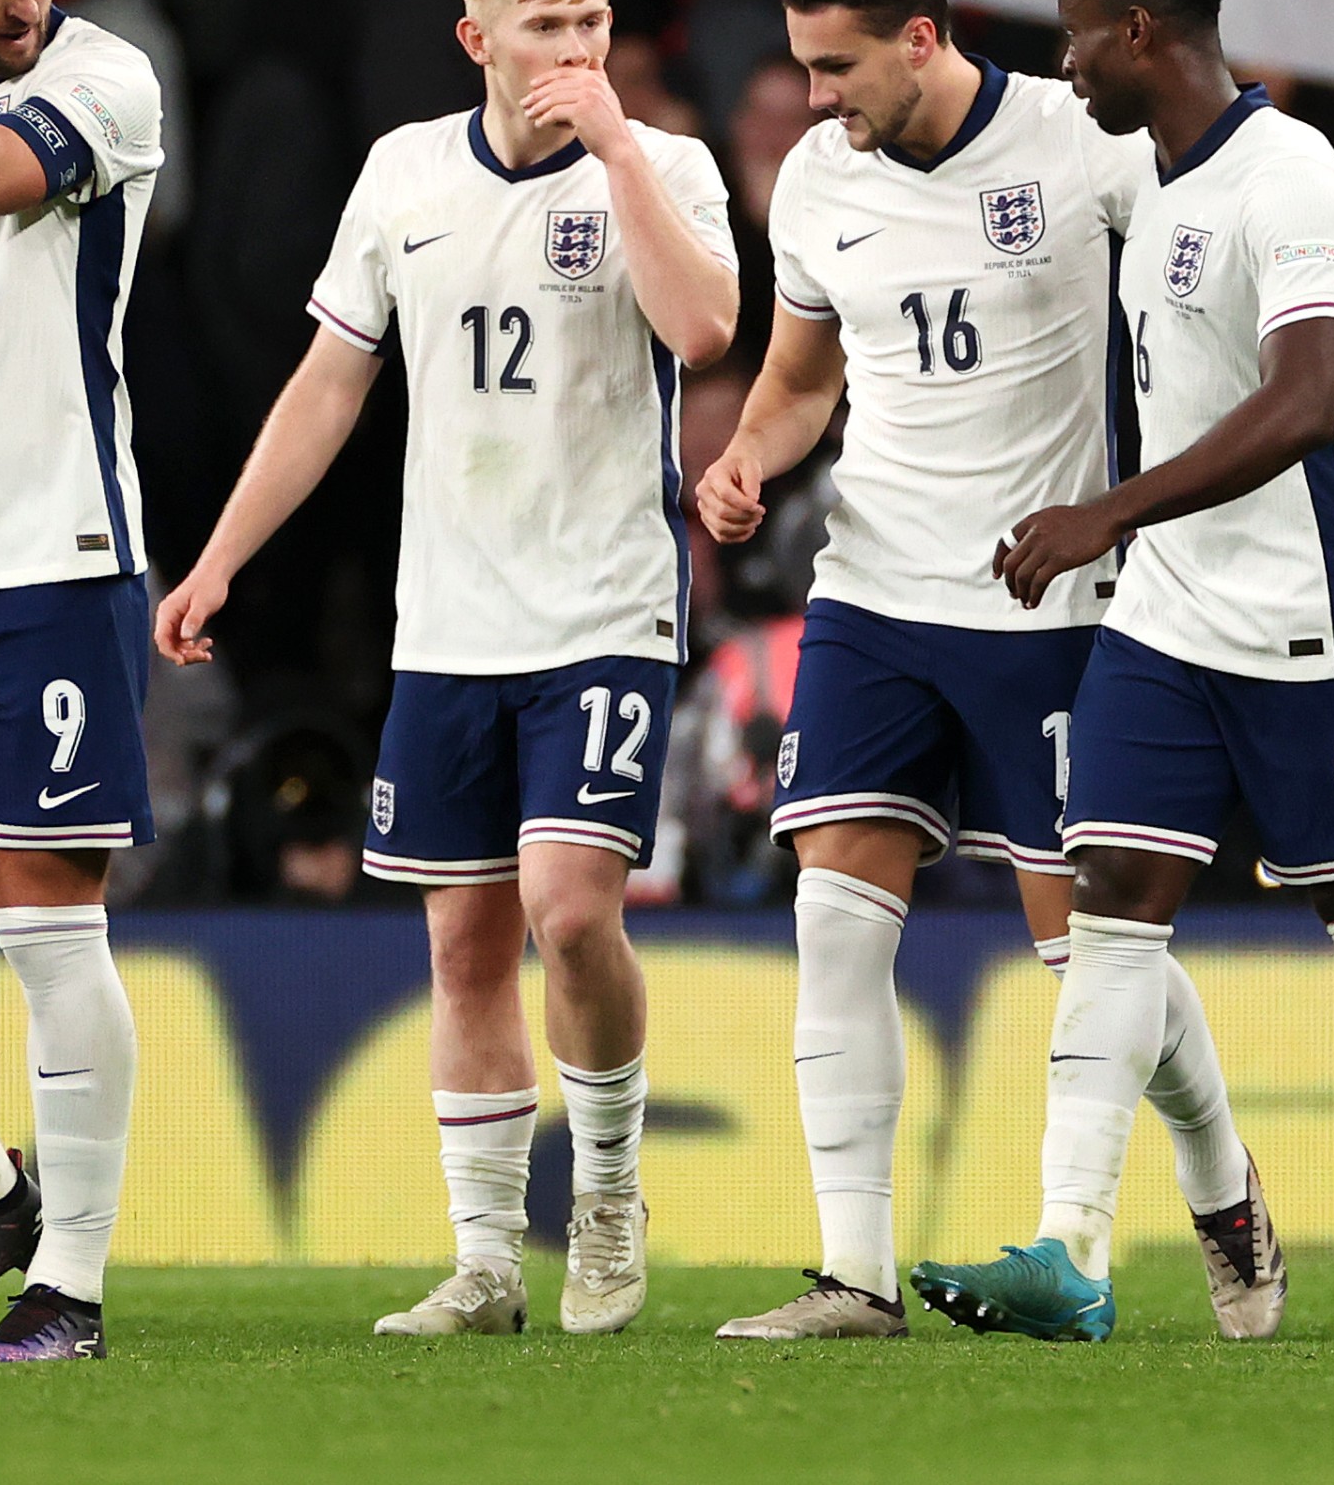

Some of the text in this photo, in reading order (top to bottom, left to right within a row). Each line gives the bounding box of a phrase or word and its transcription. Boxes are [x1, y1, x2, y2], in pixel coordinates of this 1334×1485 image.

[71, 87, 122, 145] FOUNDATION
[460, 304, 536, 394] 12
[900, 286, 982, 375] 16
[1136, 309, 1153, 397] 6
[41, 679, 86, 772] 9
[579, 685, 651, 782] 12
